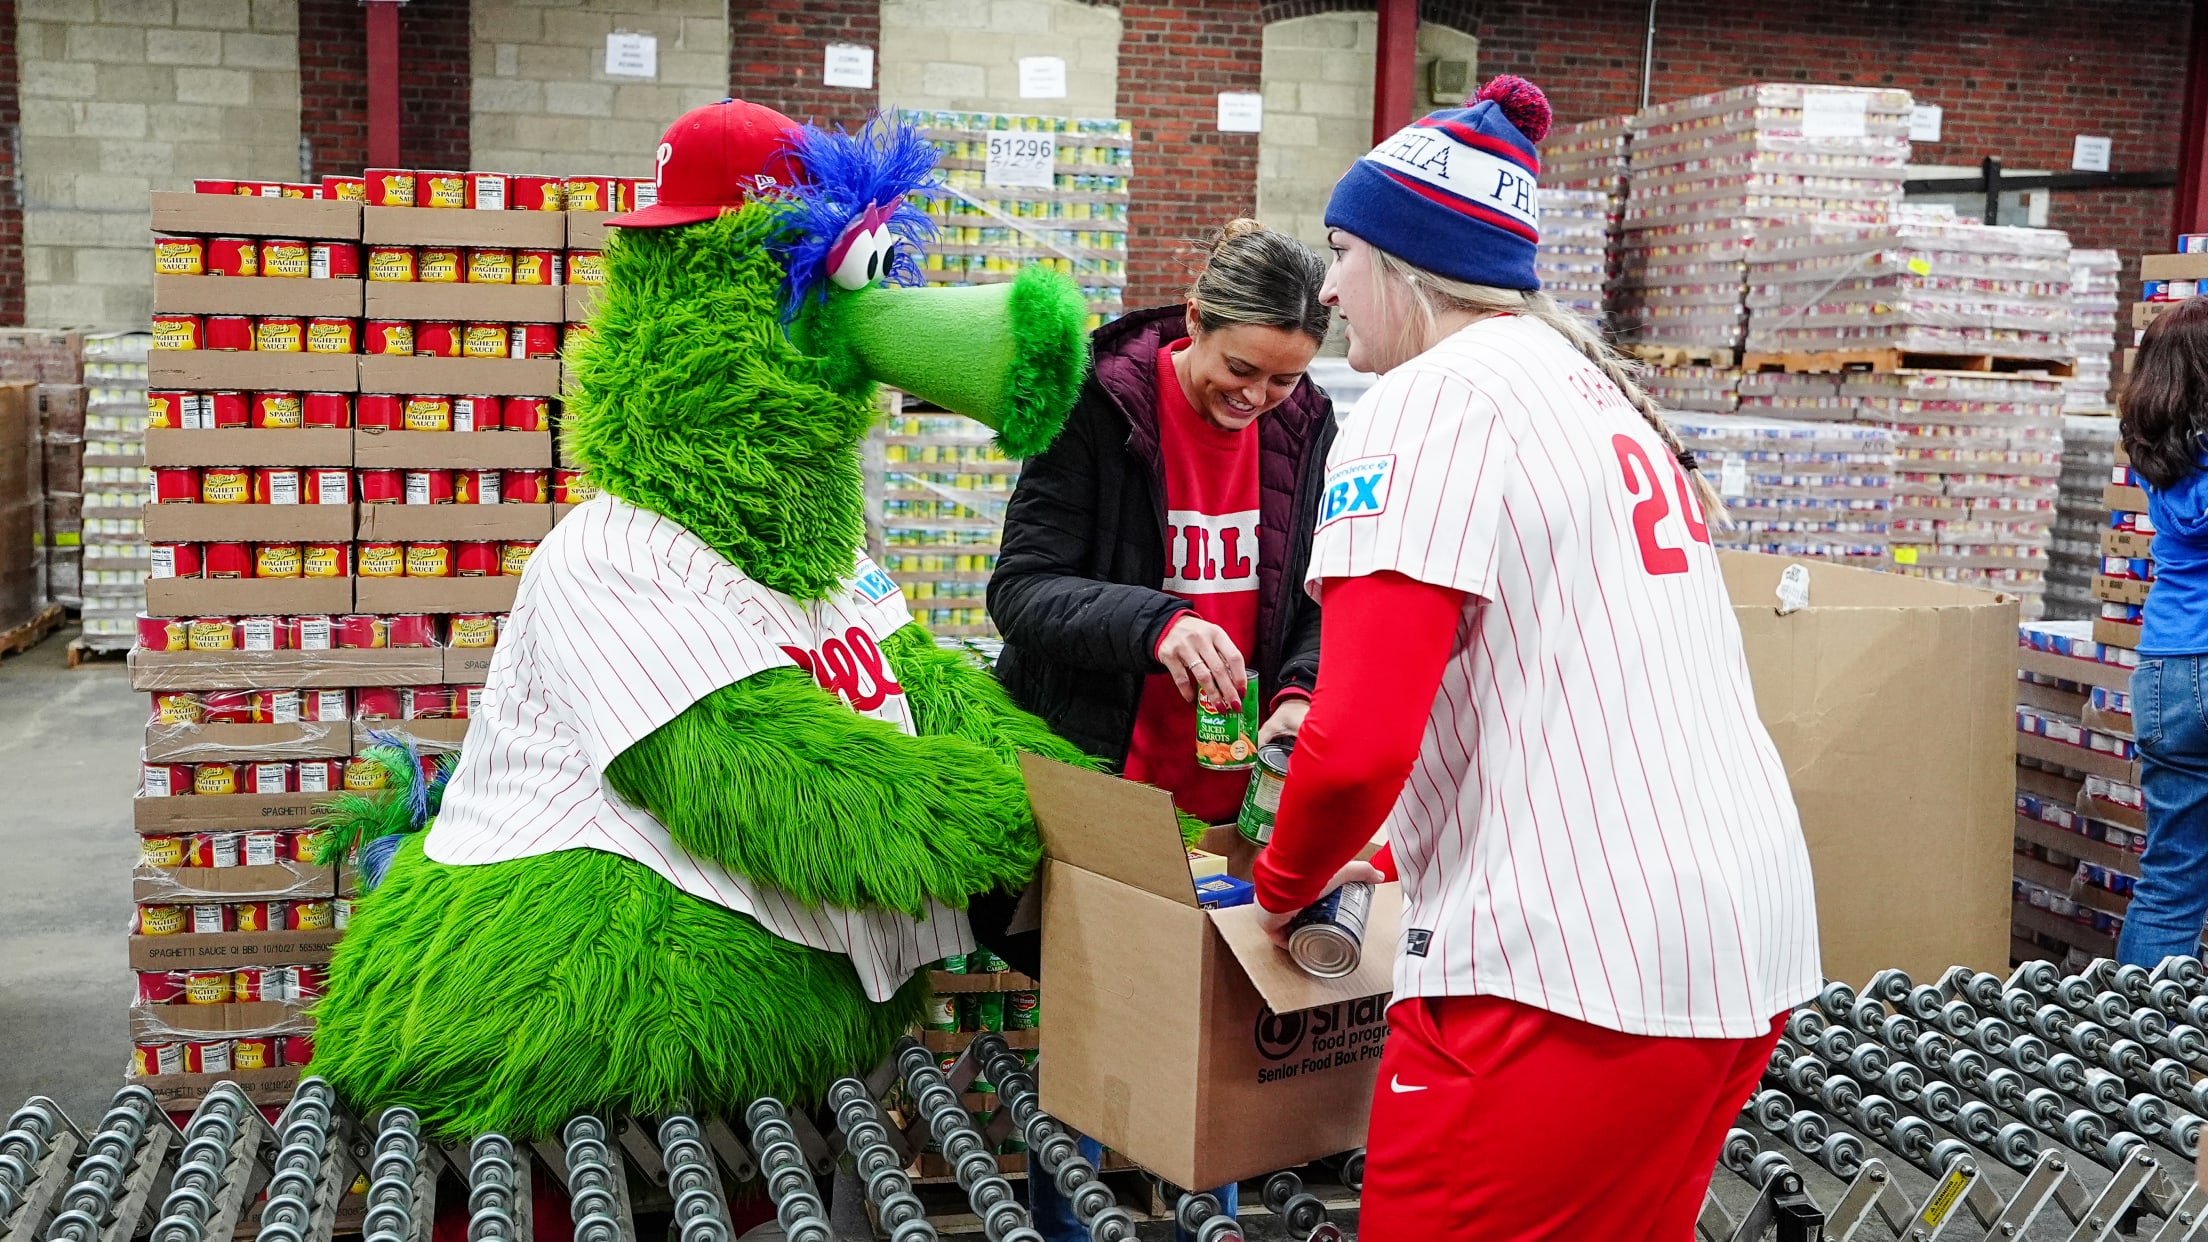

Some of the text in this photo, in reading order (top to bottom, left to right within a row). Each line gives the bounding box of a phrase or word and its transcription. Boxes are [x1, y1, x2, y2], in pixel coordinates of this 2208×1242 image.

[991, 138, 1051, 157] 51296
[656, 142, 673, 187] P
[277, 265, 303, 273] SAUCE
[374, 271, 400, 279] SAUCE
[478, 272, 504, 280] SAUCE
[410, 565, 434, 573] SAUCE
[462, 636, 488, 644] SAUCE
[1201, 723, 1225, 734] SLICED
[1199, 730, 1230, 742] CARROTS
[261, 806, 307, 817] SPAGHETTI
[152, 923, 179, 932] SAUCE
[149, 947, 195, 958] SPAGHETTI
[199, 946, 227, 956] SAUCE
[242, 944, 258, 954] BBD
[263, 943, 295, 953] 10/10/27
[193, 993, 220, 1001] SAUCE
[1312, 1029, 1345, 1053] food
[1257, 1063, 1299, 1084] Senior
[1301, 1053, 1331, 1075] Food
[1334, 1050, 1357, 1067] Box
[1934, 1180, 1954, 1206] WARNING
